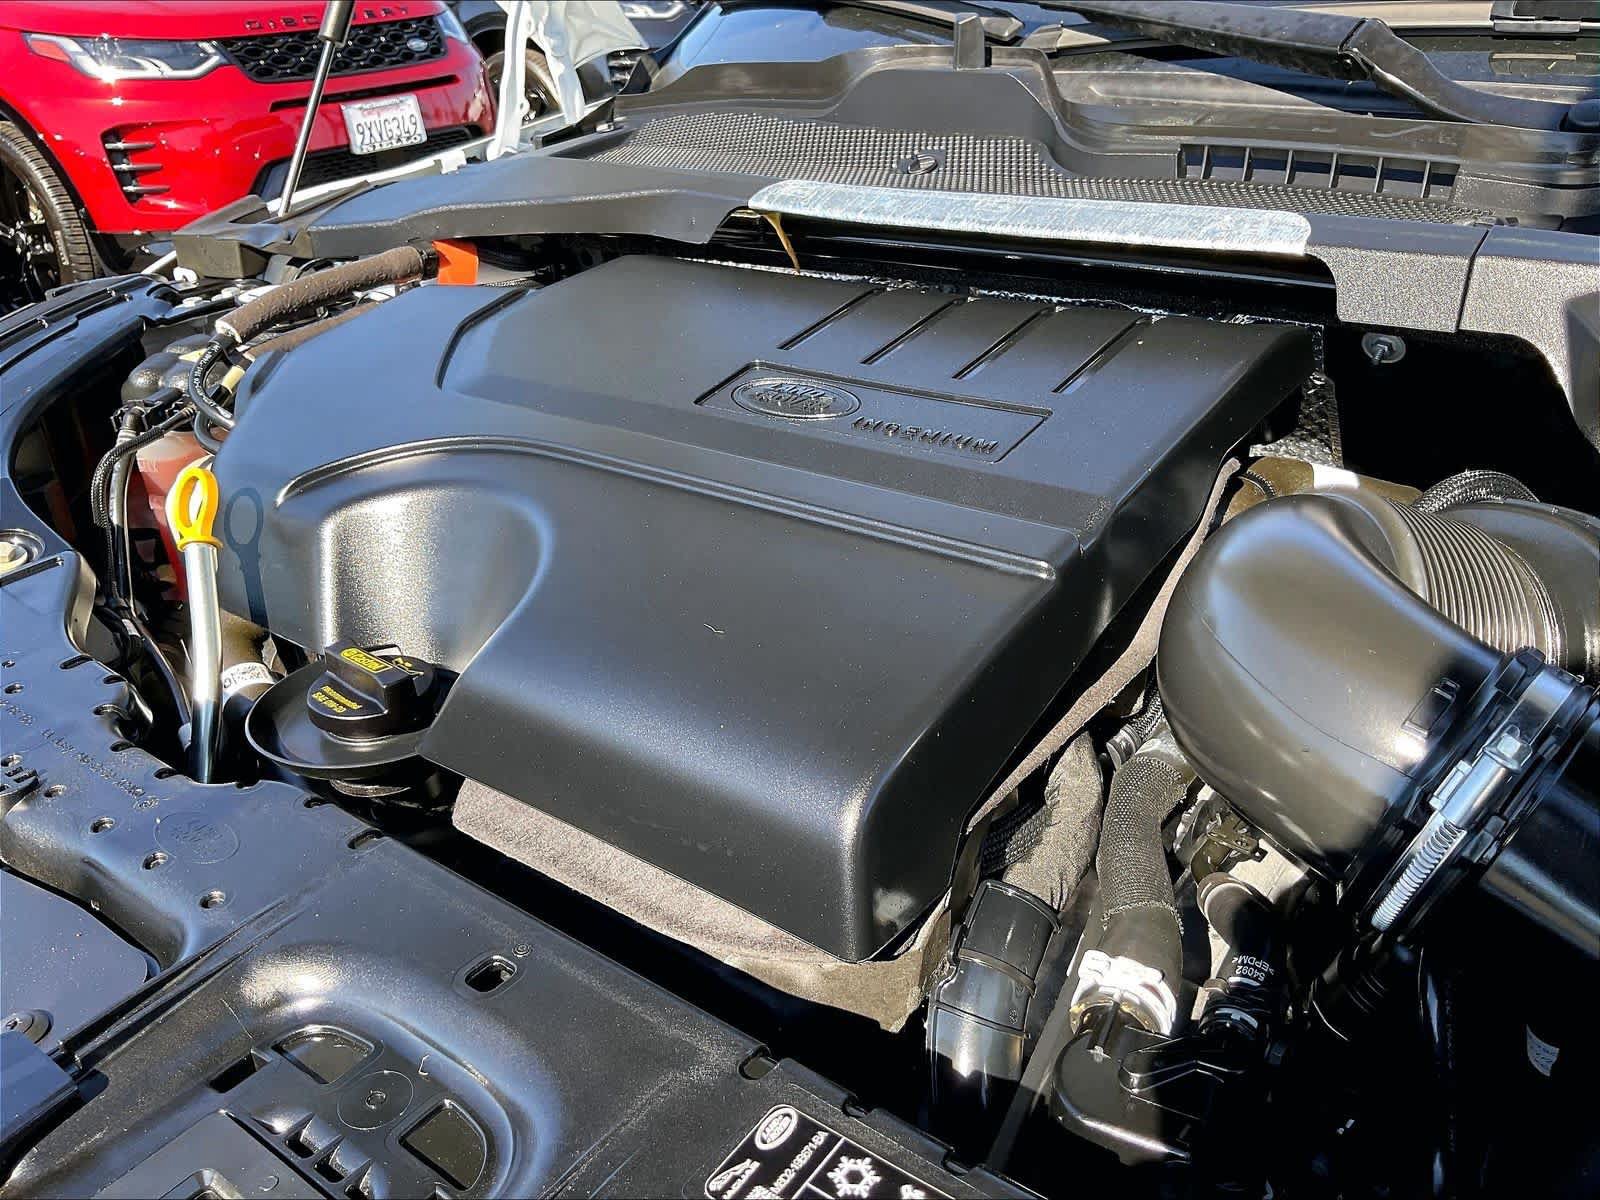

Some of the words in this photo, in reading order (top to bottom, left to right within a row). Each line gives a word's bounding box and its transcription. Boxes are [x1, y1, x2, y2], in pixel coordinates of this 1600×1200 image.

[244, 6, 408, 30] DISCERY
[356, 113, 418, 146] 9XVG349
[852, 416, 1000, 455] INGENIUM
[1235, 965, 1266, 982] 54092
